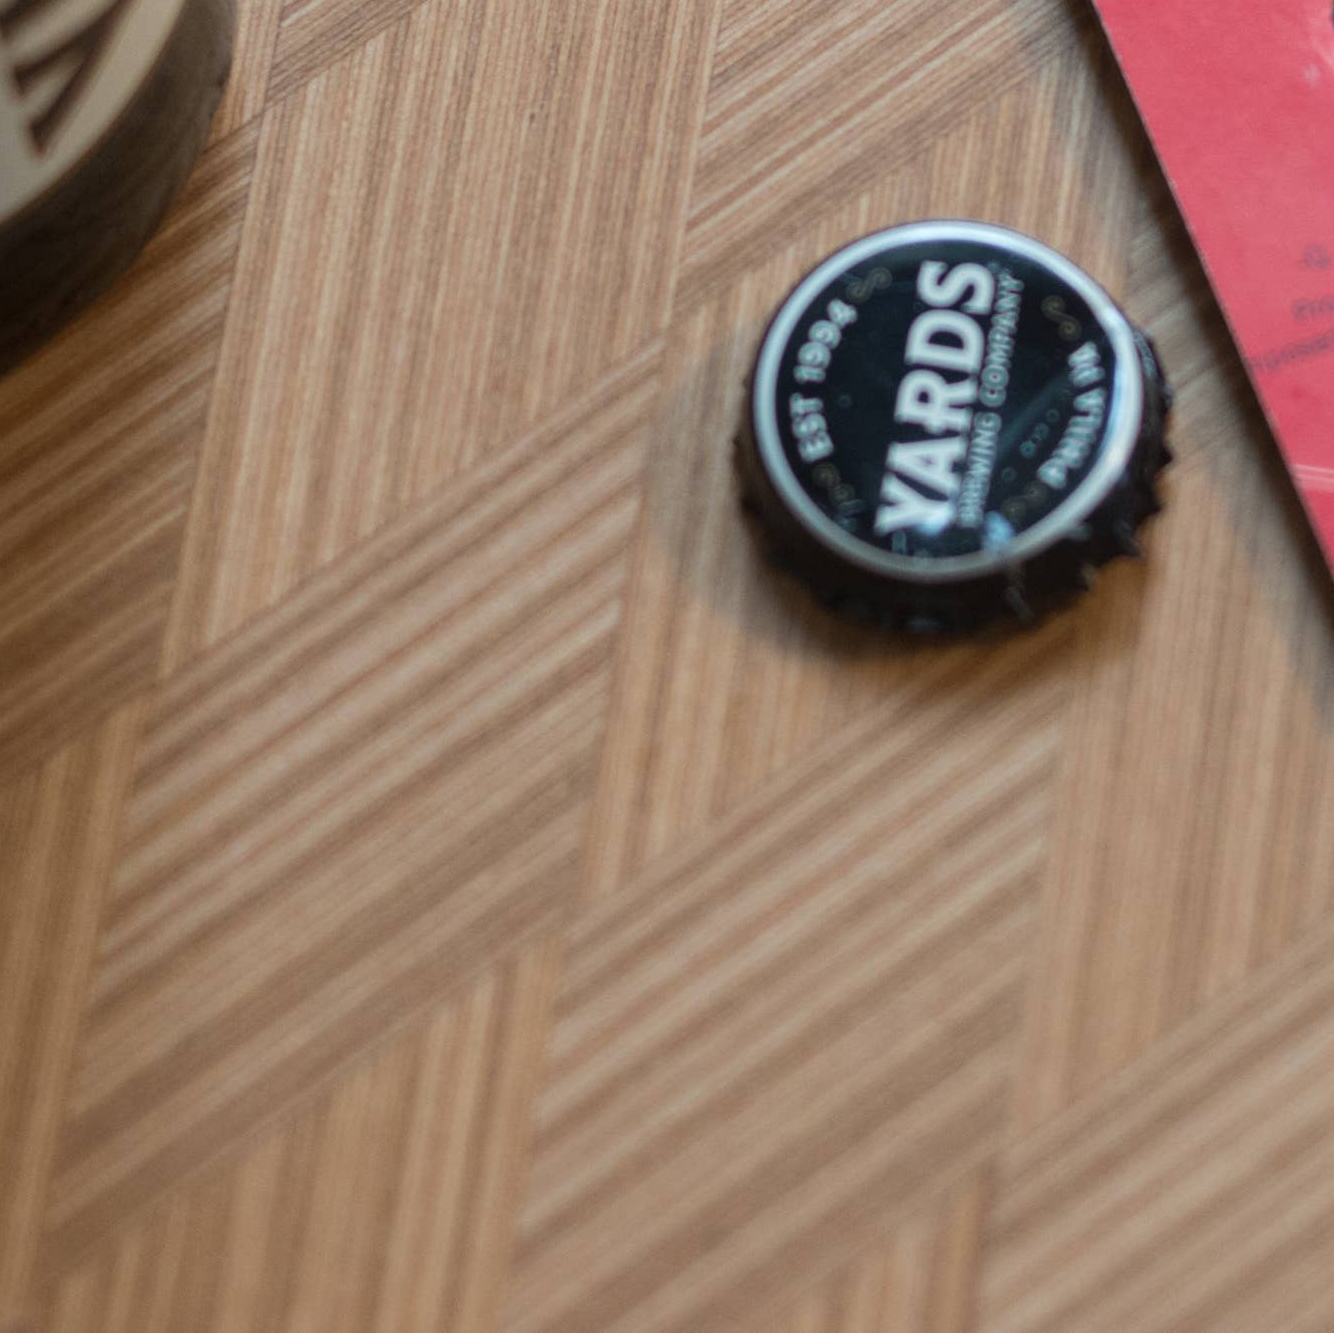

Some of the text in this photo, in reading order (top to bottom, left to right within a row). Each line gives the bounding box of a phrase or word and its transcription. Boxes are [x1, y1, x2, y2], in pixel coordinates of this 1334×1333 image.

[793, 297, 859, 385] 1994
[872, 259, 997, 538] YARDS
[955, 266, 1026, 529] BREWING COMPANY
